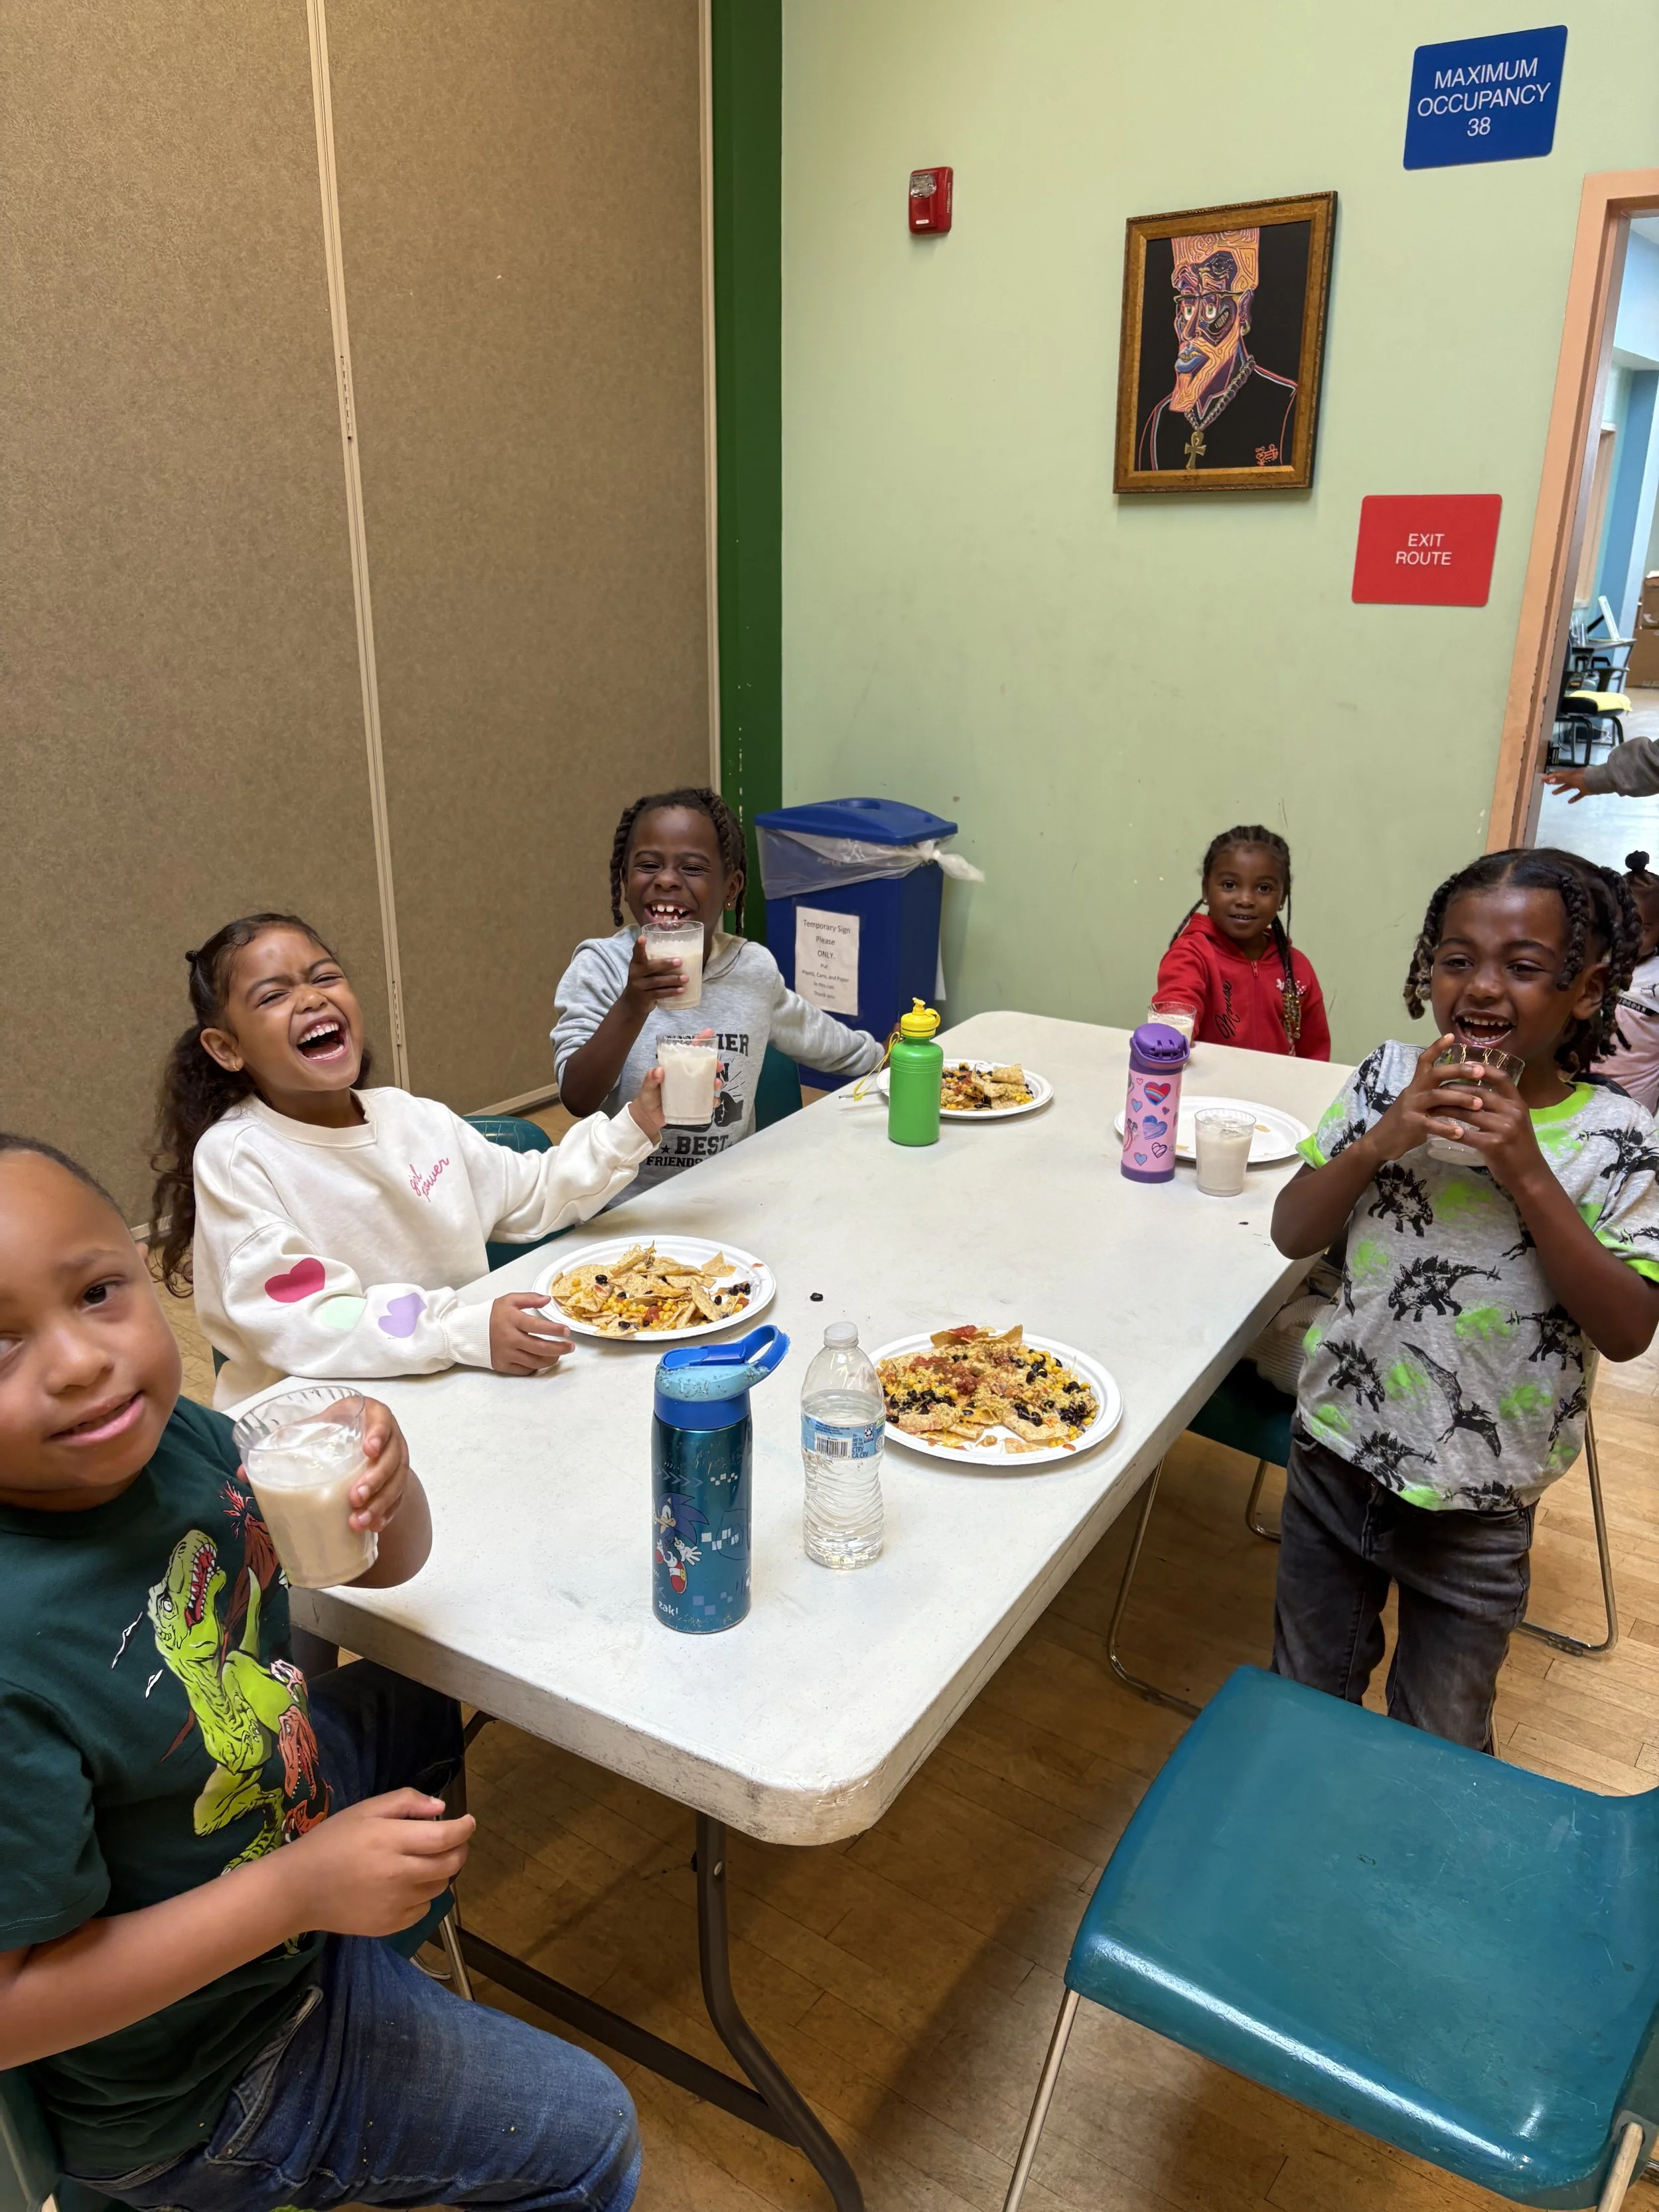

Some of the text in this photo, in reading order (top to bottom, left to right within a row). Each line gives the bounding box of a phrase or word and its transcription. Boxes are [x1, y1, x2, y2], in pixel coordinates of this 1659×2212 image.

[1435, 57, 1538, 89] MAXIMUM
[1417, 82, 1551, 116] OCCUPANCY
[1467, 117, 1490, 136] 38
[1407, 533, 1445, 547] EXIT
[1396, 551, 1452, 565] ROUTE
[803, 919, 851, 934] Temporary Sign
[816, 936, 835, 945] Please
[817, 950, 835, 960] ONLY.
[1215, 979, 1240, 1039] Mouse
[674, 1134, 729, 1155] BEST
